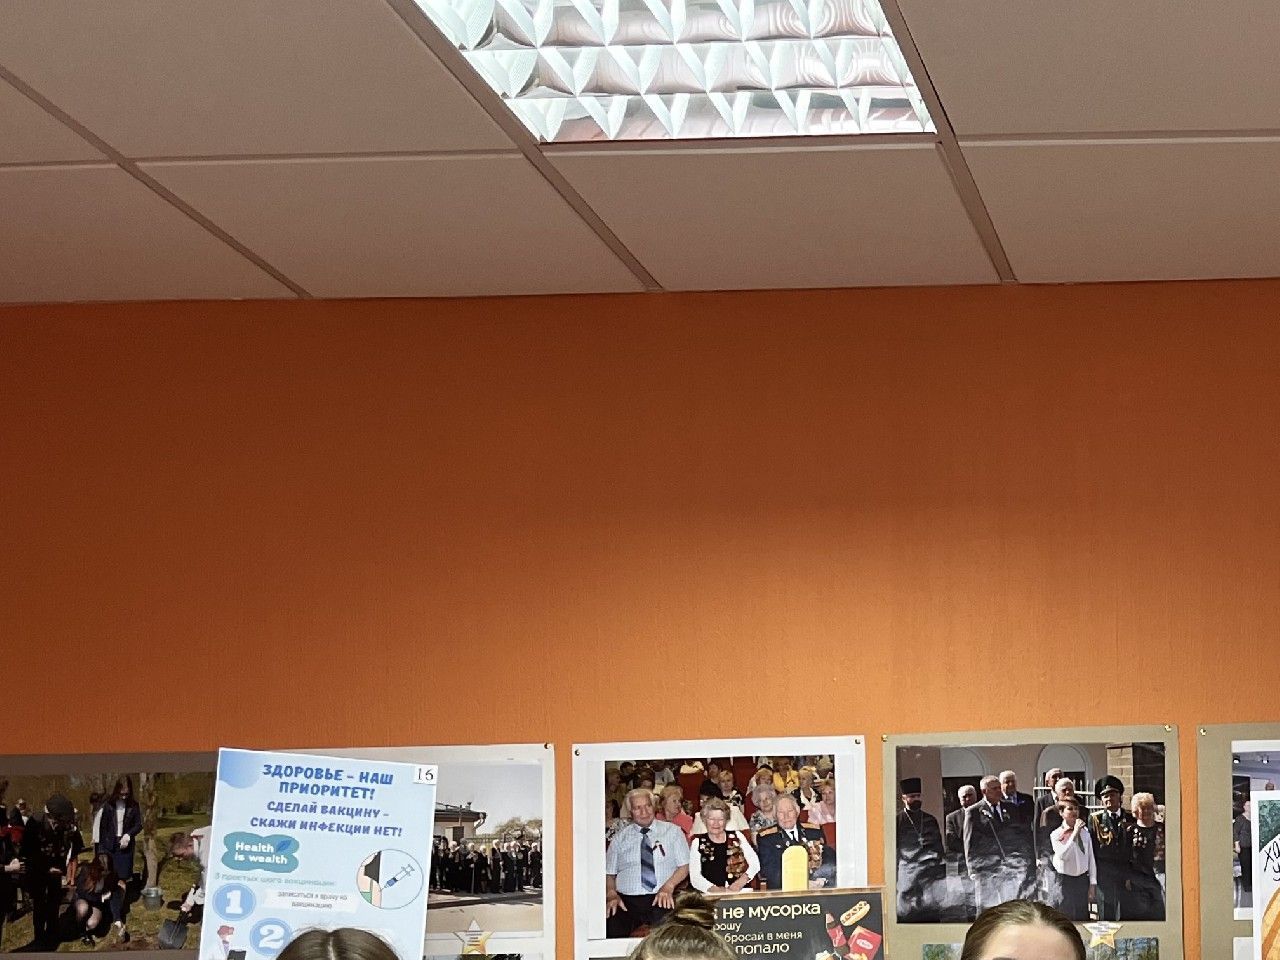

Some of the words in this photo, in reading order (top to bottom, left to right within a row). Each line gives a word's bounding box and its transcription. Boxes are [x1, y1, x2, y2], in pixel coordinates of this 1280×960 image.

[263, 764, 344, 781] ЗДОРОВЬЕ
[359, 772, 394, 785] НАШ
[416, 768, 434, 781] 16
[279, 781, 375, 800] ПРИОРИТЕТ!
[267, 801, 317, 814] СДЕЛАЙ
[320, 804, 381, 819] ВАКЦИНУ
[250, 817, 297, 830] СКАЖИ
[299, 821, 371, 835] ИНФЕКЦИИ
[374, 825, 403, 837] НЕТ!
[235, 841, 274, 853] Health
[234, 853, 245, 862] is
[249, 853, 288, 865] wealth
[225, 890, 243, 914] 1
[722, 907, 745, 919] не
[748, 902, 821, 921] мусорка
[713, 922, 742, 932] рошу
[258, 924, 284, 949] 2
[724, 931, 765, 944] бросай
[767, 932, 774, 941] в
[776, 931, 803, 940] меня
[735, 942, 790, 955] попало
